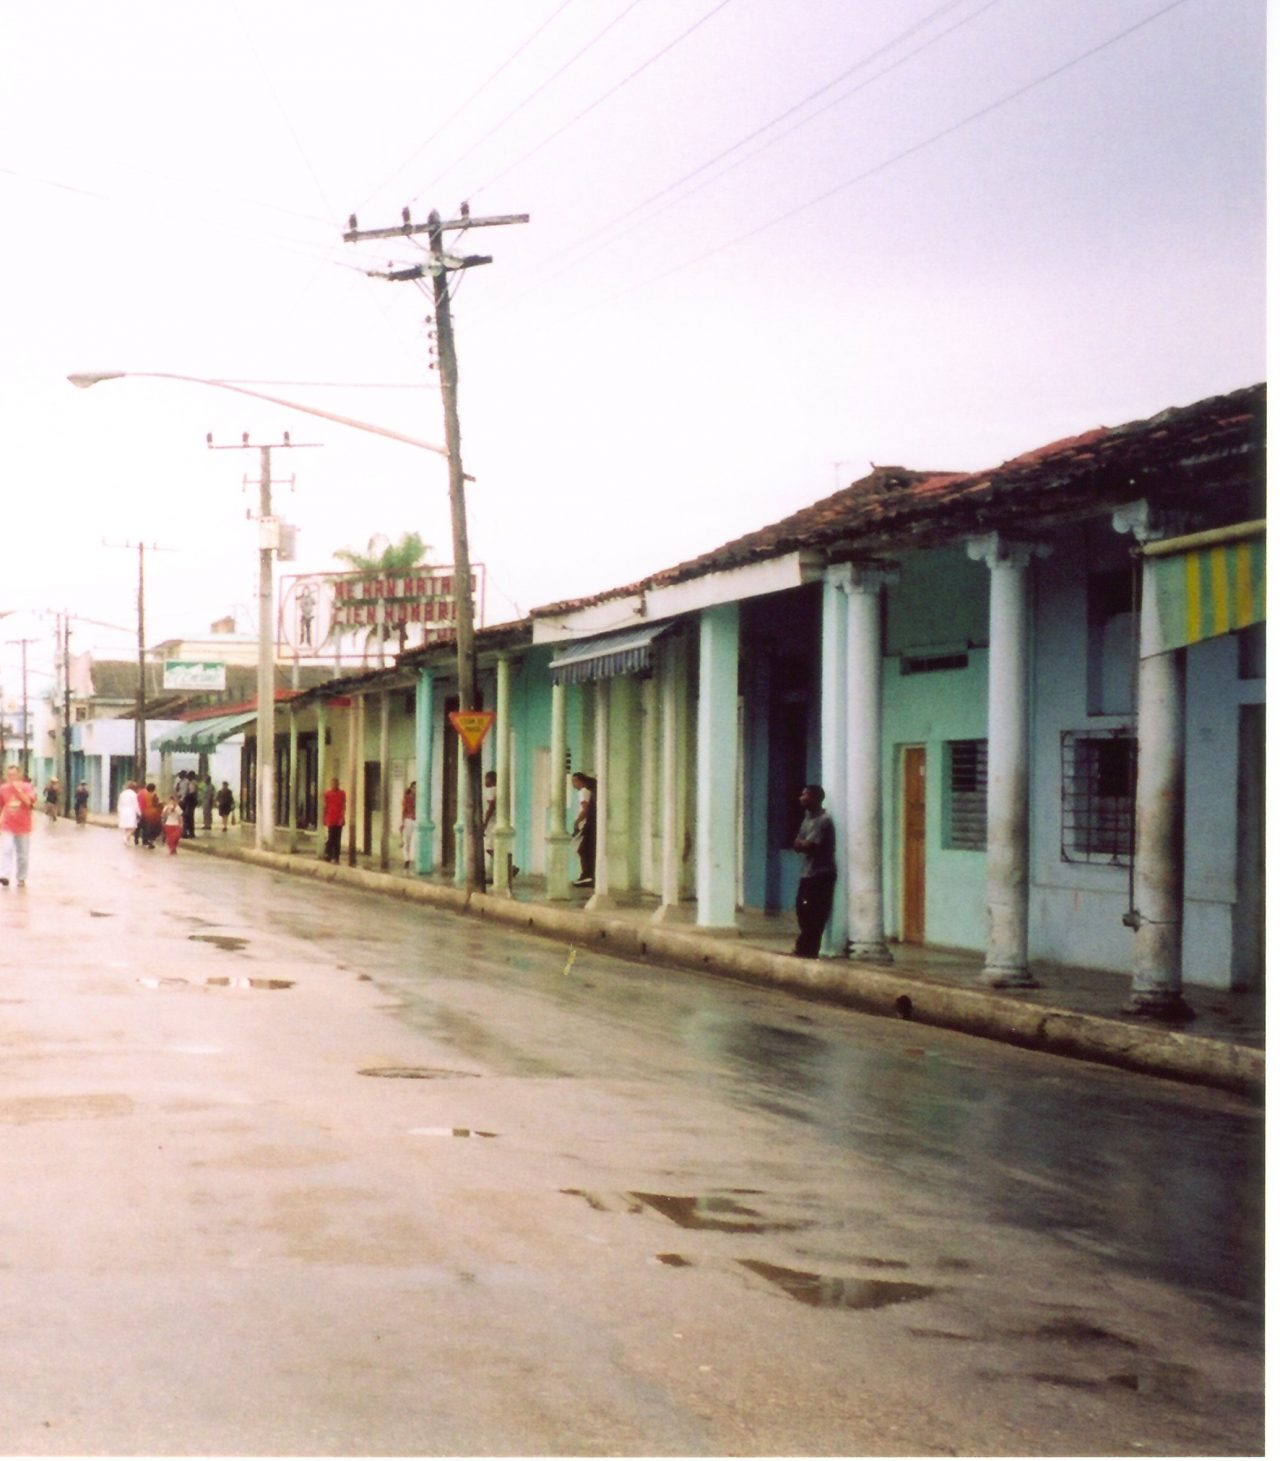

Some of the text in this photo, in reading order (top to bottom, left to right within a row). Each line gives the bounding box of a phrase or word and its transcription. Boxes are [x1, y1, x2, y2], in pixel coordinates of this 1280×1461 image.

[363, 577, 395, 598] HAN
[404, 574, 476, 598] MATAO
[333, 601, 475, 625] CIEN HOMBRE
